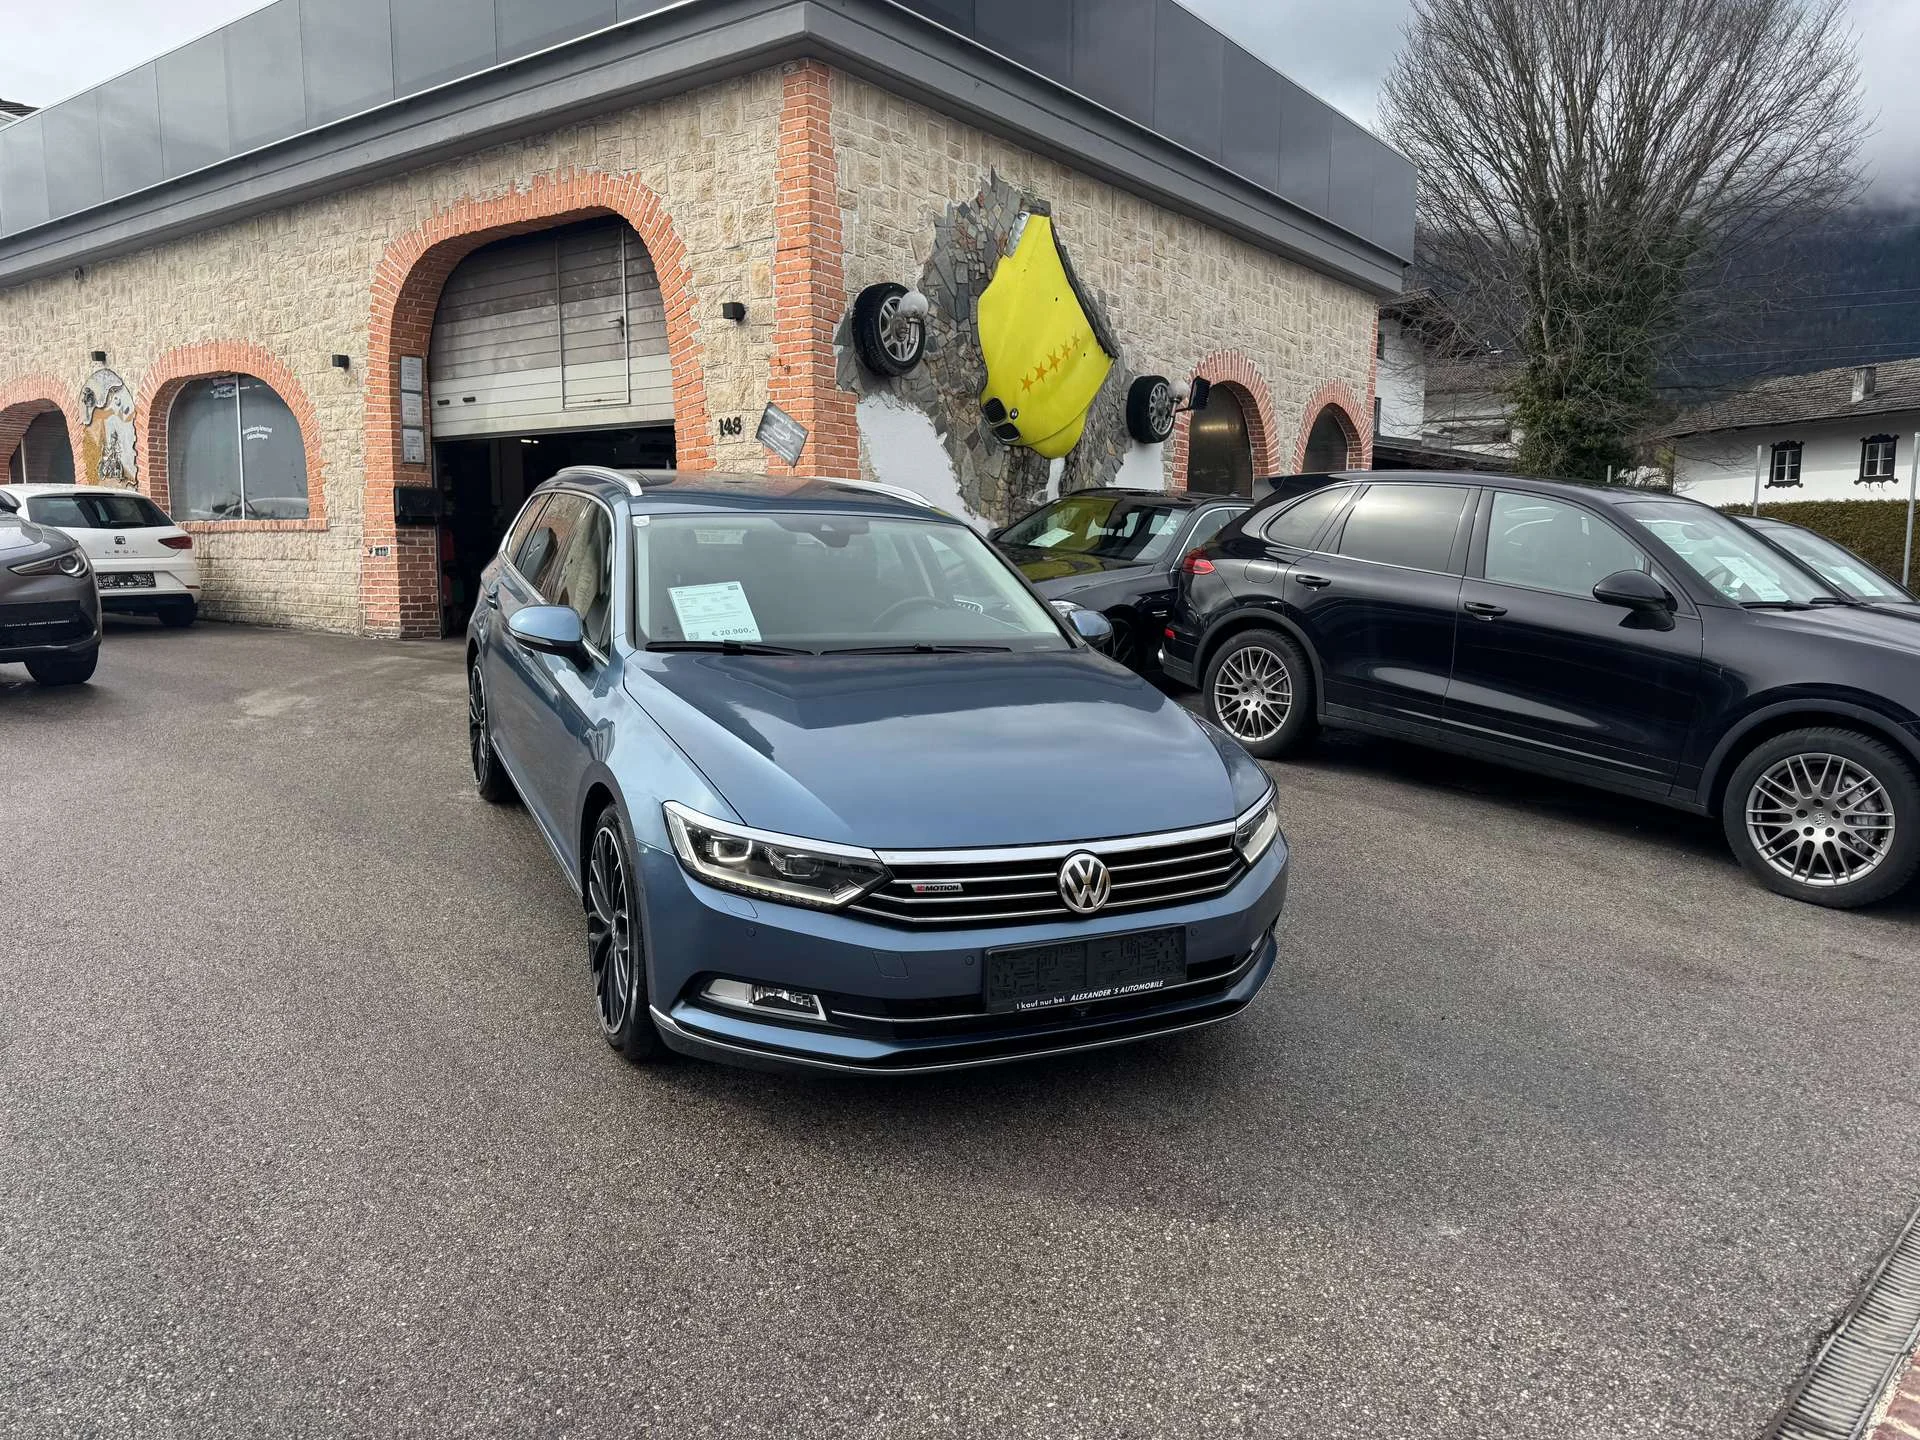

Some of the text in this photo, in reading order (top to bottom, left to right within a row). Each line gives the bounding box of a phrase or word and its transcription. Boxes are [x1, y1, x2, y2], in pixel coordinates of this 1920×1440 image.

[718, 415, 742, 436] 148
[1021, 1000, 1038, 1008] kauf
[1053, 995, 1065, 1004] bei
[1119, 981, 1164, 994] AUTOMOBILE
